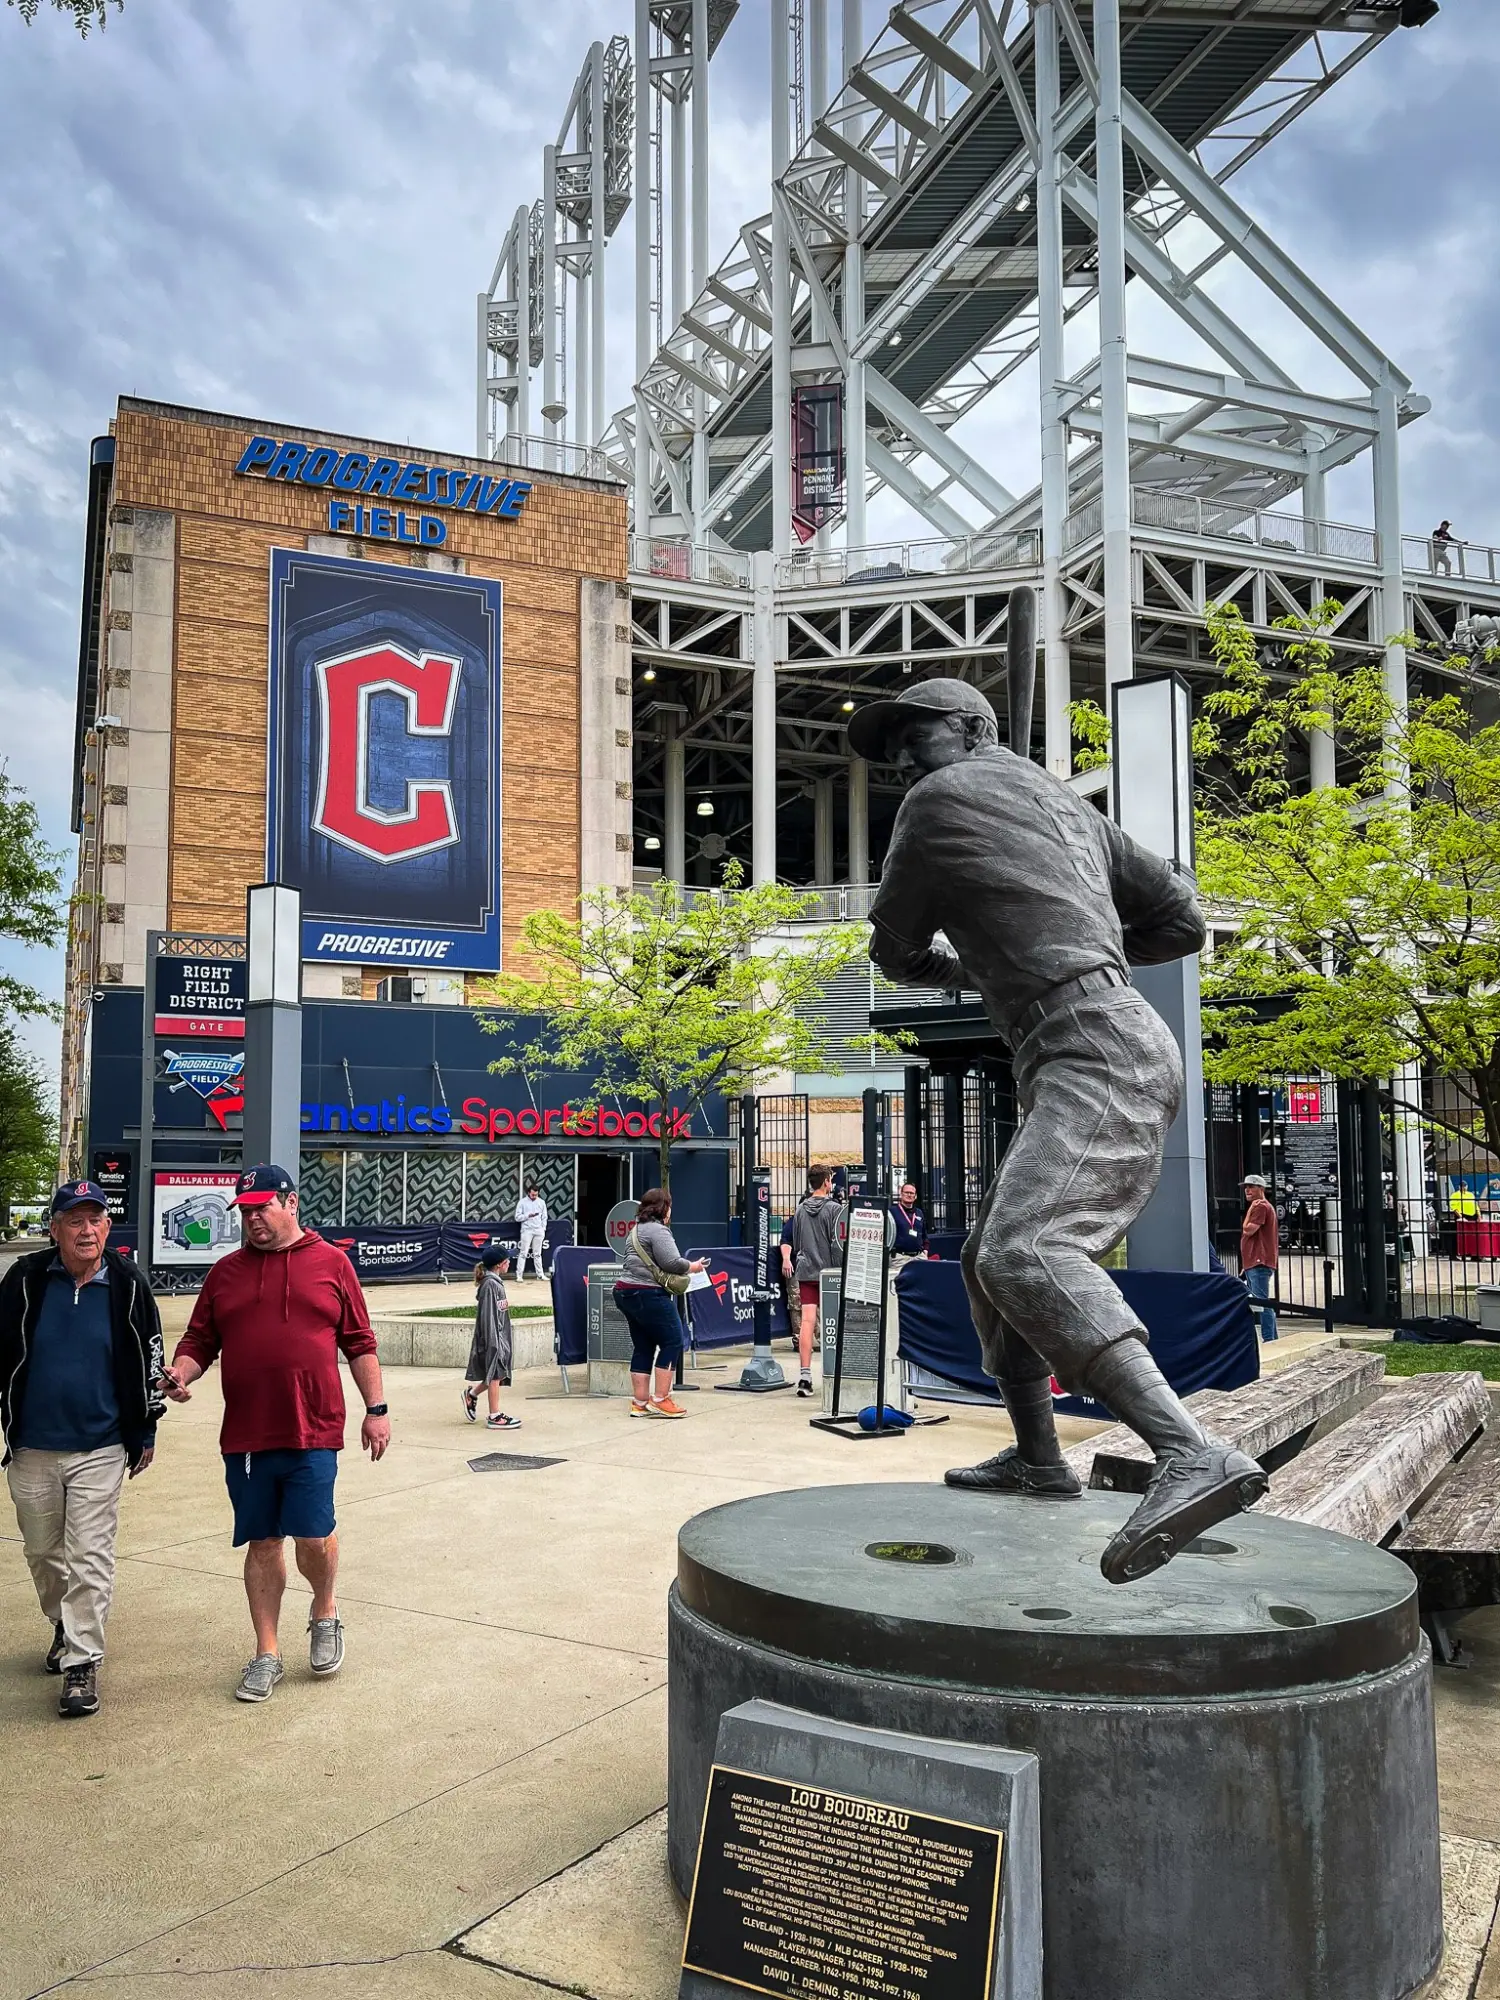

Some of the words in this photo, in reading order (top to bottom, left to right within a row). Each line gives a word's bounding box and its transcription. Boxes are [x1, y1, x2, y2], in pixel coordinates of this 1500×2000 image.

[235, 436, 533, 519] PROGRESSIVE
[803, 474, 835, 484] PENNANT
[803, 485, 834, 495] DISTRICT
[328, 501, 448, 546] FIELD
[317, 933, 454, 959] PROGRESSIVE
[183, 965, 232, 980] RIGHT
[185, 981, 230, 994] FIELD
[170, 995, 244, 1010] DISTRICT
[189, 1022, 224, 1032] GATE
[173, 1060, 236, 1071] PROGRESSIVE
[191, 1074, 220, 1084] FIELD
[300, 1095, 453, 1133] anatics
[461, 1097, 692, 1143] Sportsbook
[98, 1171, 125, 1180] Fanatics
[169, 1176, 215, 1185] BALLPARK
[217, 1177, 237, 1185] MAP
[104, 1195, 123, 1205] ow
[758, 1206, 769, 1262] PROGRESSIVE
[358, 1240, 423, 1256] Fanatics
[358, 1254, 413, 1267] Sportsbook
[757, 1262, 767, 1287] FIELD
[591, 1309, 600, 1336] 1997
[825, 1318, 836, 1350] 1995
[1082, 1396, 1095, 1405] TM
[789, 1788, 820, 1809] LOU
[823, 1796, 909, 1831] BOUDREAU
[730, 1802, 741, 1811] THE
[741, 1804, 775, 1819] STABILIZING
[775, 1813, 794, 1824] FORCE
[795, 1818, 818, 1830] BEHIND
[818, 1823, 830, 1833] THE
[830, 1826, 855, 1839] INDIANS
[856, 1833, 880, 1845] DURING
[881, 1839, 893, 1848] THE
[925, 1850, 937, 1859] THE
[938, 1853, 972, 1868] YOUNGEST
[731, 1792, 752, 1803] AMONG
[752, 1797, 764, 1806] THE
[764, 1800, 780, 1810] MOST
[781, 1804, 807, 1817] BELOVED
[807, 1811, 832, 1823] INDIANS
[832, 1817, 859, 1829] PLAYERS
[869, 1825, 880, 1835] HIS
[922, 1838, 957, 1853] BOUDREAU
[958, 1847, 973, 1857] WAS
[734, 1812, 762, 1826] MANAGER
[780, 1824, 796, 1834] CLUB
[822, 1835, 835, 1844] LOU
[836, 1838, 859, 1850] GUIDED
[859, 1844, 871, 1853] THE
[872, 1847, 898, 1860] INDIANS
[908, 1856, 921, 1866] THE
[738, 1824, 762, 1835] SECOND
[762, 1830, 783, 1841] WORLD
[783, 1835, 804, 1846] SERIES
[804, 1840, 849, 1858] CHAMPIONSHIP
[874, 1858, 898, 1871] DURING
[899, 1864, 915, 1875] THAT
[916, 1869, 942, 1882] SEASON
[943, 1876, 956, 1886] THE
[758, 1838, 810, 1858] PLAYER/MANAGER
[810, 1852, 833, 1864] BATTED
[846, 1861, 860, 1871] AND
[860, 1865, 886, 1878] EARNED
[887, 1872, 901, 1882] MVP
[723, 1842, 736, 1851] OVER
[737, 1845, 760, 1857] THIRTEEN
[761, 1852, 784, 1864] SEASONS
[797, 1861, 819, 1873] MEMBER
[828, 1869, 838, 1878] THE
[862, 1878, 874, 1887] LOU
[875, 1882, 887, 1891] WAS
[893, 1886, 926, 1901] SEVEN-TIME
[927, 1895, 955, 1909] ALL-STAR
[956, 1903, 969, 1913] AND
[742, 1916, 783, 1936] CLEVELAND
[790, 1930, 825, 1948] 1938-1950
[834, 1943, 851, 1956] MLB
[852, 1948, 882, 1965] CAREER
[889, 1959, 928, 1978] 1938-1952
[743, 1940, 789, 1962] MANAGERIAL
[902, 1989, 920, 2000] 1960
[762, 1964, 789, 1982] DAVID
[847, 1959, 884, 1978] 1942-1950
